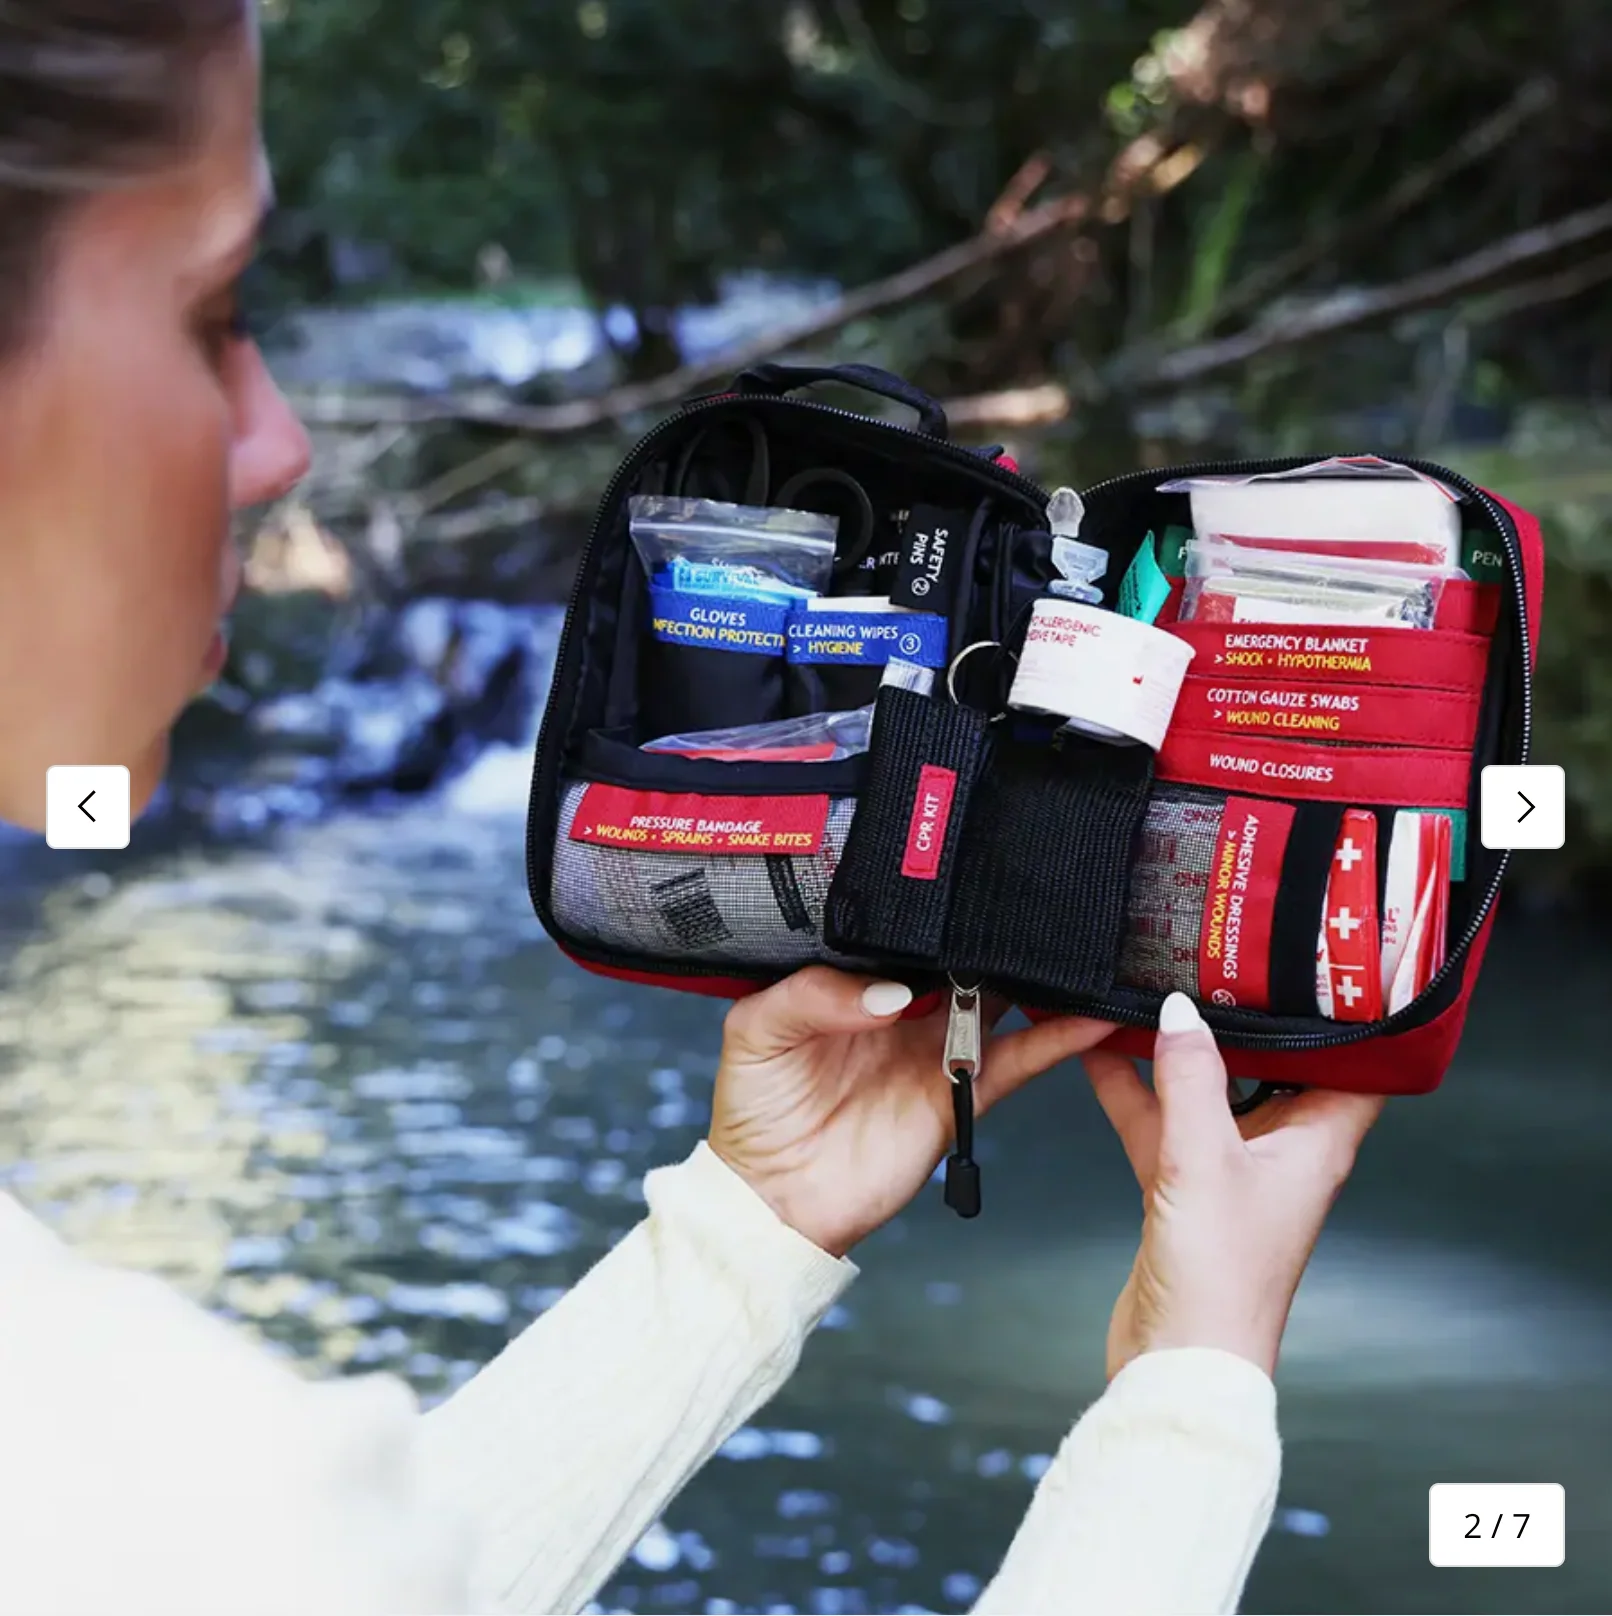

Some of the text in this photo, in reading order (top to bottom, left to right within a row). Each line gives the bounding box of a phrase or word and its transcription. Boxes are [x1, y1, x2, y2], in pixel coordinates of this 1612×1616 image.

[910, 532, 929, 565] PINS
[925, 528, 949, 583] SAFETY
[690, 607, 747, 627] GLOVES
[788, 624, 899, 640] CLEANING WIPES
[1225, 634, 1369, 653] EMERGENCY BLANKET
[808, 641, 864, 656] HYGIENE
[1225, 652, 1372, 671] SHOCK HYPOTHERMIA
[1207, 688, 1360, 711] COTTON GAUZE SWABS
[1226, 710, 1340, 730] WOUND CLEANING
[1209, 753, 1334, 782] WOUND CLOSURES
[629, 815, 763, 834] PRESSURE BANDAGE
[916, 792, 940, 852] CPR KIT
[596, 824, 813, 847] WOUNDS SPRAINS SNAKE BITES
[1232, 813, 1260, 892] ADHESIVE
[1206, 840, 1236, 960] MINOR WOUNDS
[1222, 894, 1244, 980] DRESSINGS
